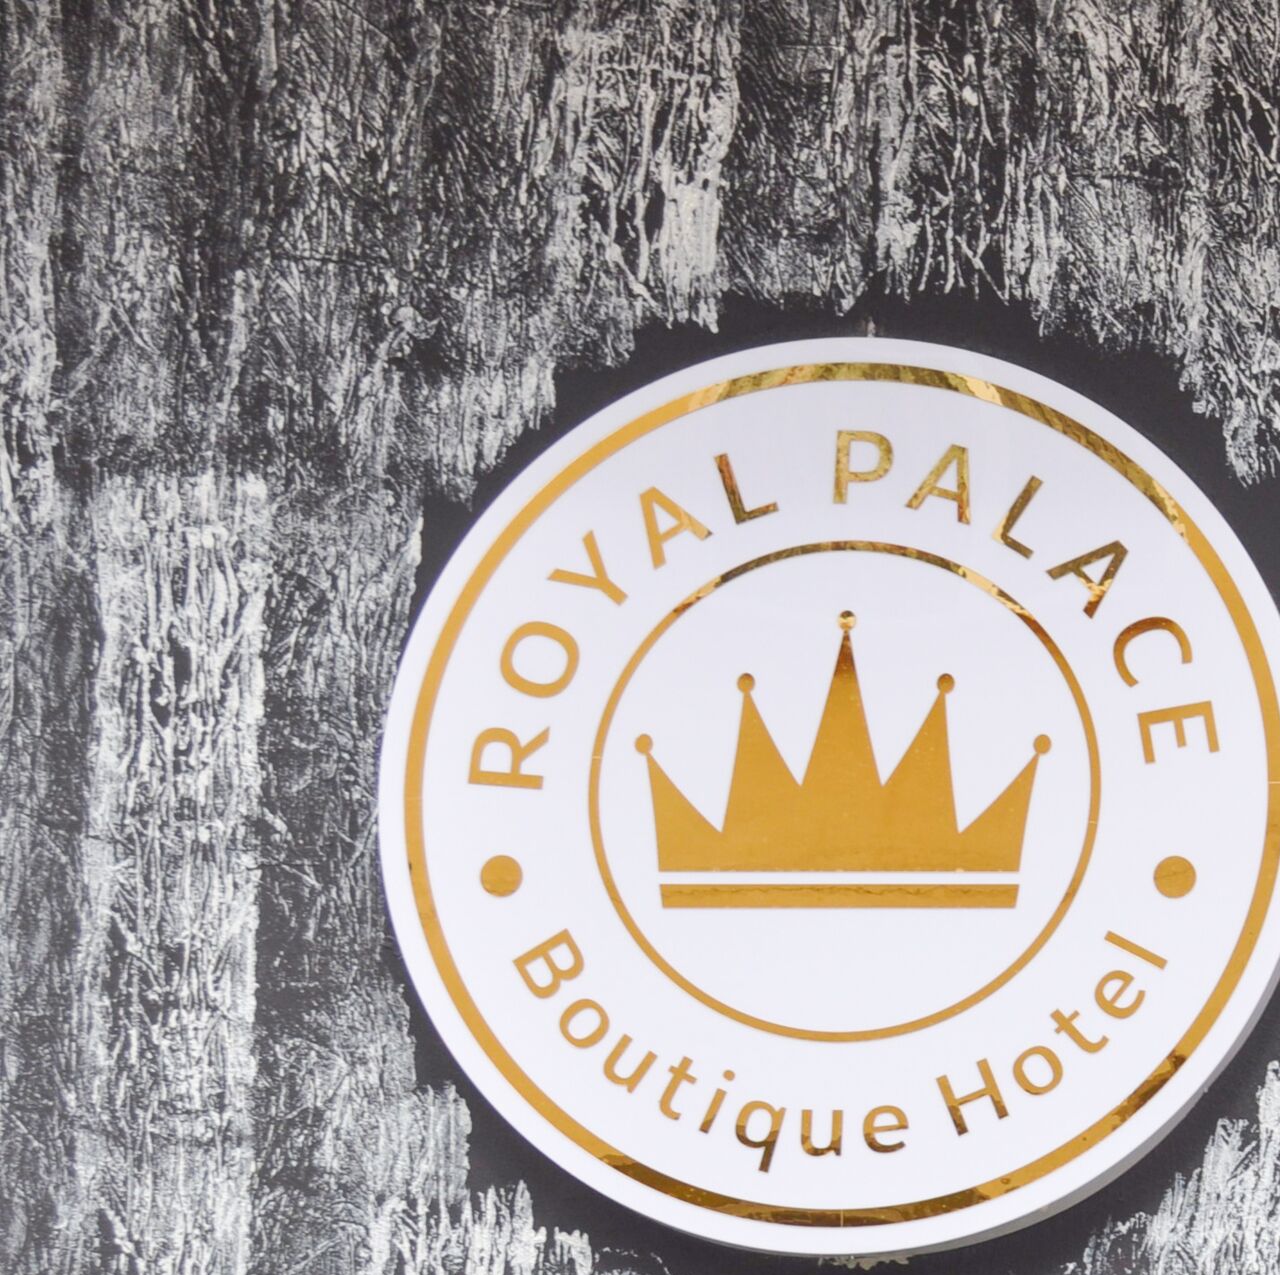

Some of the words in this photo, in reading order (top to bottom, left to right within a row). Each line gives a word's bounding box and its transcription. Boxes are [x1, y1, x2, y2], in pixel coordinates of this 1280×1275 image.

[468, 454, 779, 791] ROYAL
[832, 429, 1220, 765] PALACE
[512, 928, 910, 1174] Boutique
[935, 929, 1169, 1137] Hotel
